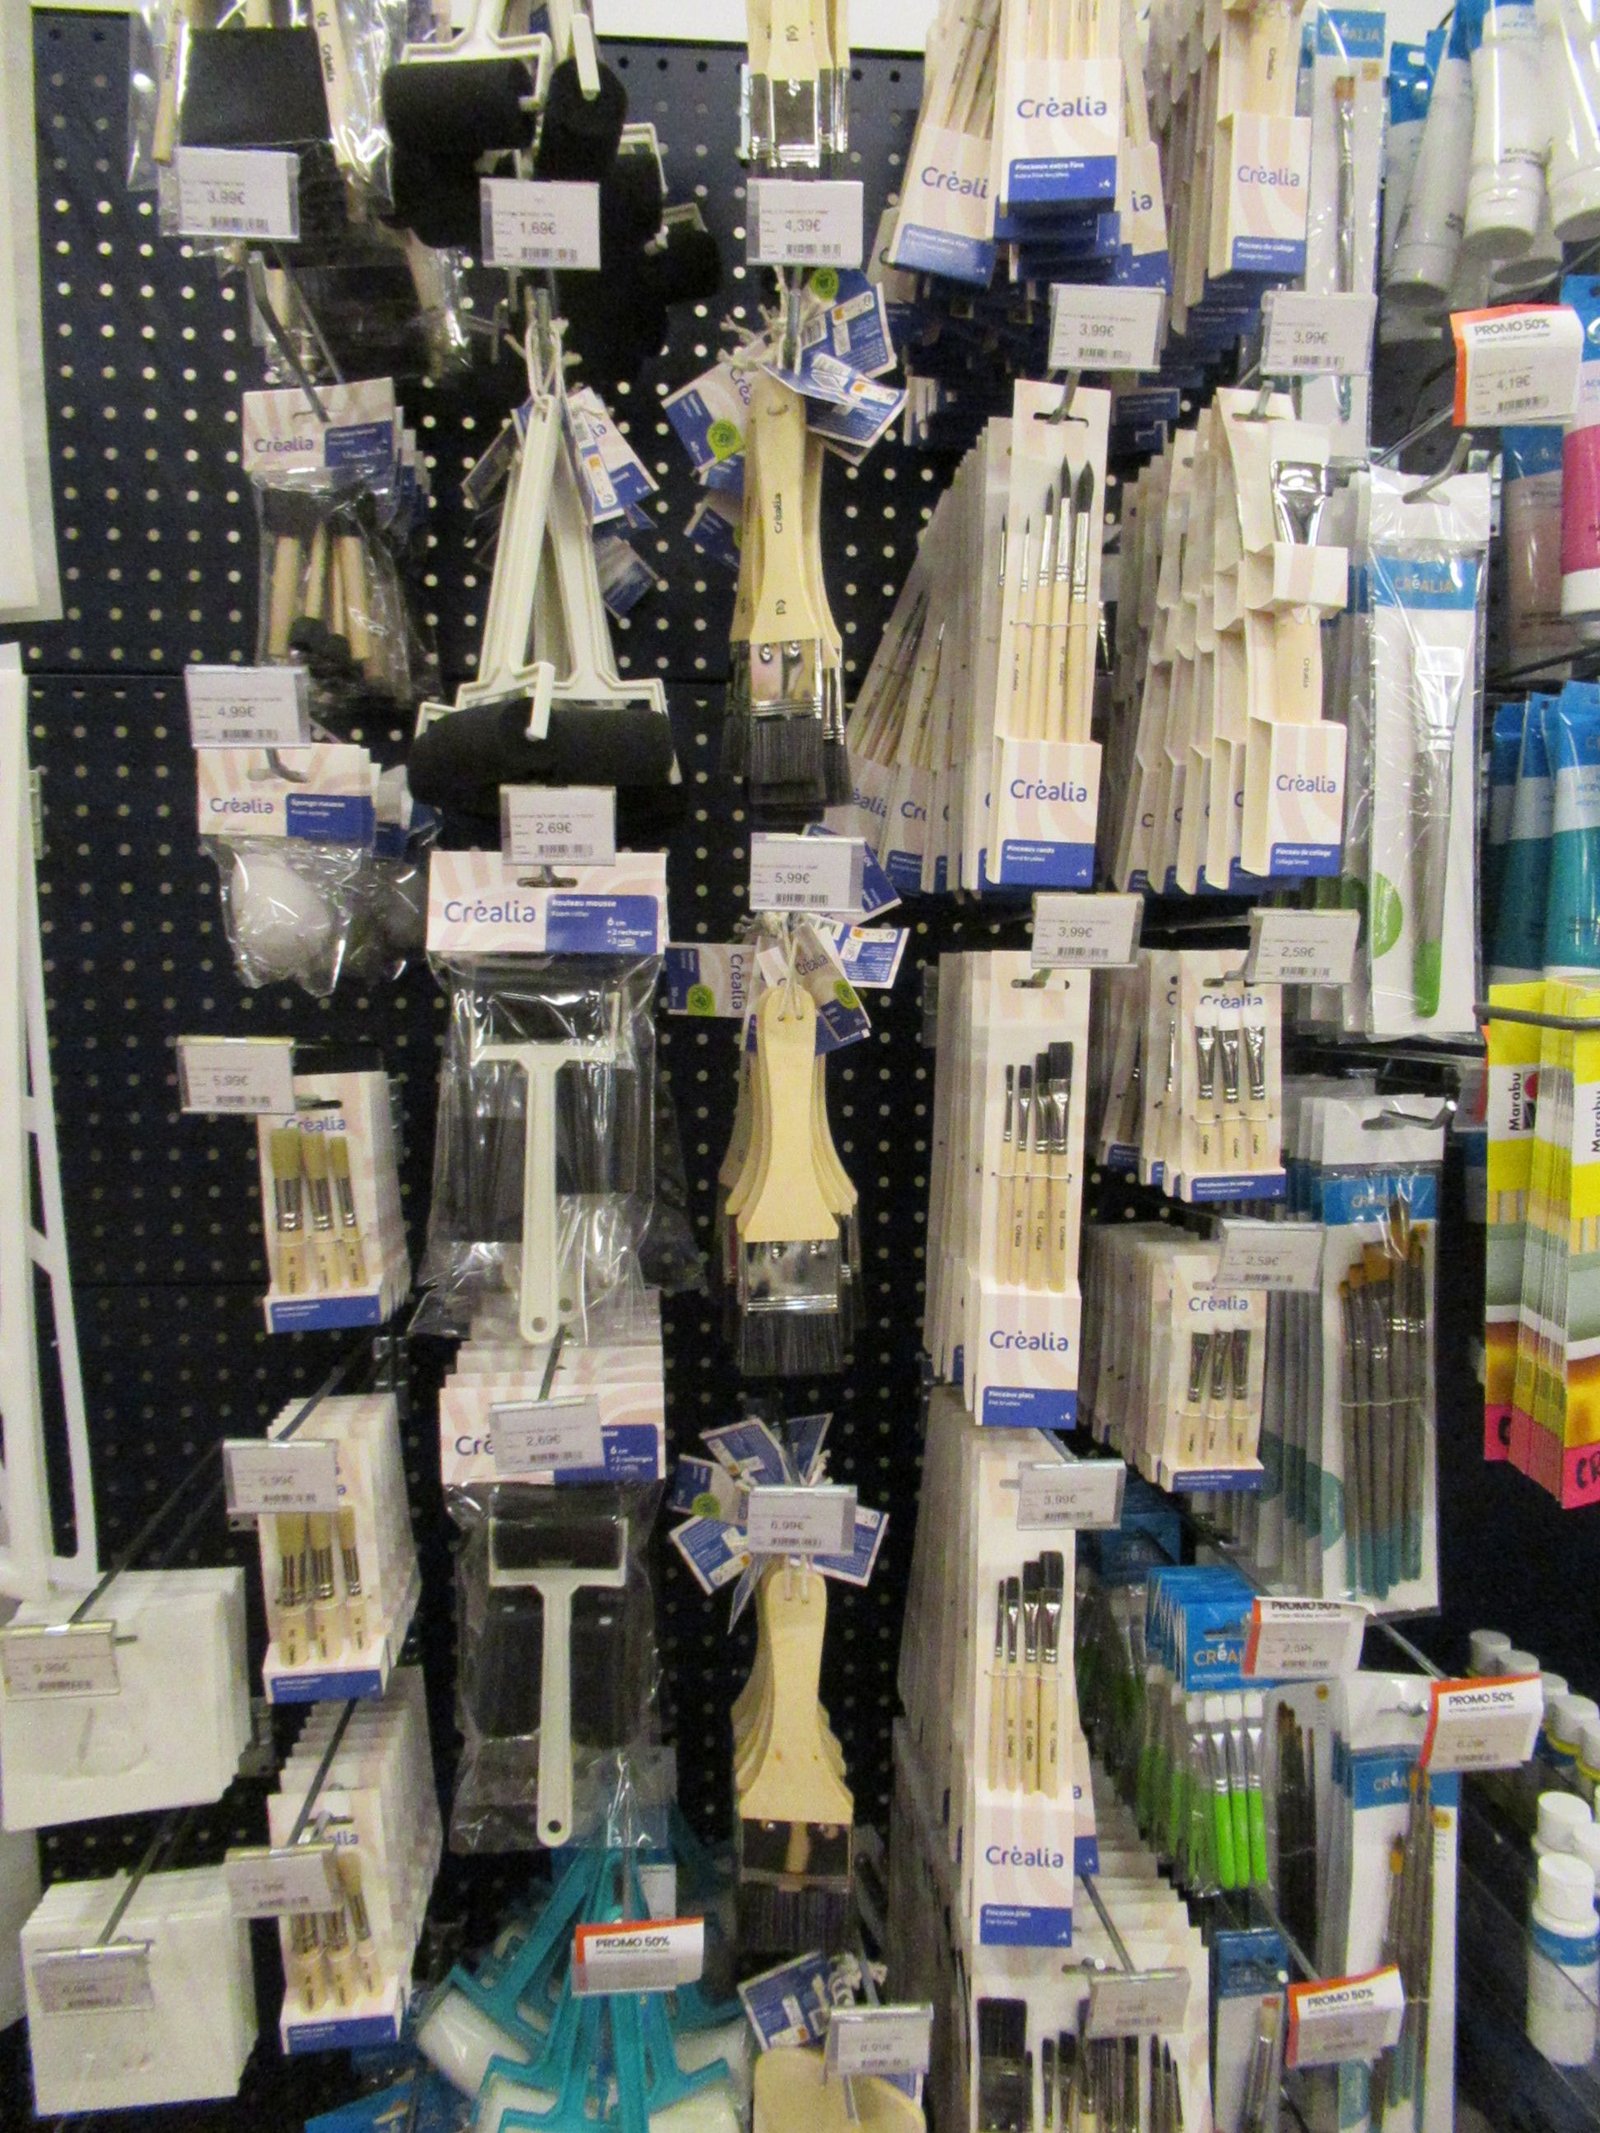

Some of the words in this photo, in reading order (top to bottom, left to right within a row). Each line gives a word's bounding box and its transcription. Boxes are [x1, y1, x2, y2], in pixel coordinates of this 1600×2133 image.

[1016, 97, 1108, 119] Créalia
[921, 166, 988, 199] Créali
[1237, 165, 1300, 187] Créalia
[1474, 321, 1523, 336] PROMO
[1524, 318, 1550, 330] 50%
[254, 436, 314, 453] Créalia
[1010, 779, 1088, 803] Créalia
[1276, 774, 1337, 794] Créalia
[210, 797, 275, 814] Créalia
[535, 822, 573, 835] 2,69€
[774, 872, 811, 885] 5,99€
[444, 900, 537, 924] Créalia
[551, 900, 583, 909] Rouleau
[585, 900, 617, 909] mousse
[617, 929, 653, 938] recharges
[1057, 926, 1093, 939] 3,99€
[731, 953, 745, 1010] Créalia
[1508, 1072, 1522, 1131] Marabu
[1188, 1296, 1249, 1312] Créalia
[989, 1330, 1069, 1351] Créalia
[1449, 1693, 1490, 1706] PROMO
[1492, 1691, 1515, 1702] 50%
[985, 1845, 1064, 1869] Créalia
[596, 1938, 643, 1948] PROMO
[645, 1936, 671, 1947] 50%
[1307, 1992, 1350, 2006] PROMO
[1351, 1988, 1375, 2000] 50%
